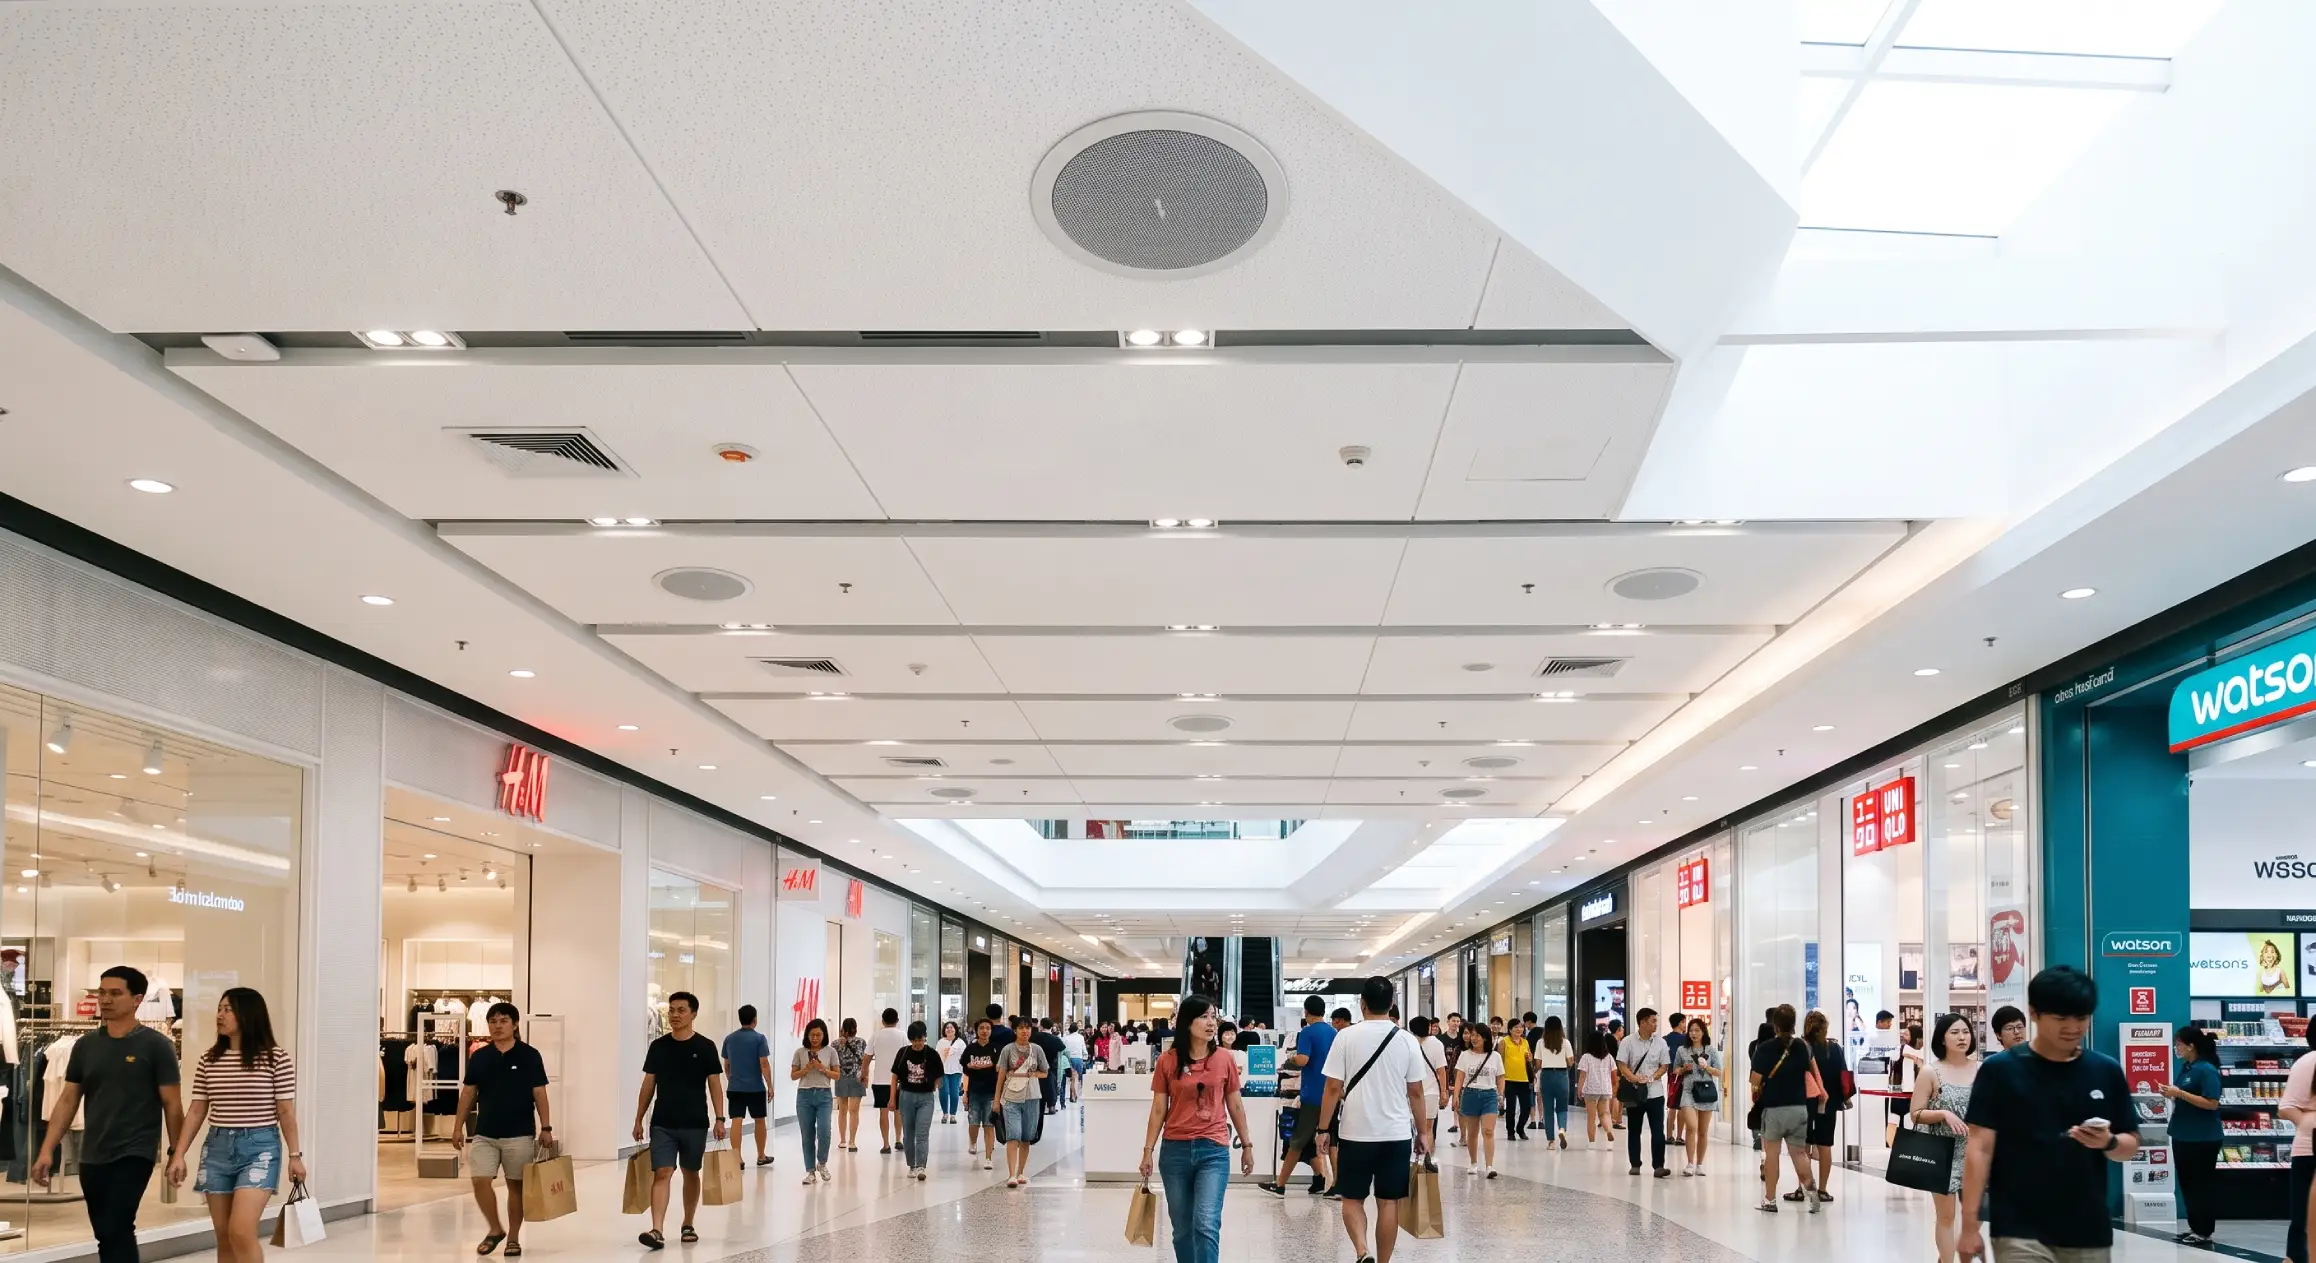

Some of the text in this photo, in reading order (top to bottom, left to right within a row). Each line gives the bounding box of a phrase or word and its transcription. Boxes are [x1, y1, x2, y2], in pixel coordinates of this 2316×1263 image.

[2191, 651, 2316, 725] watso
[1884, 785, 1903, 814] UNI
[1884, 812, 1905, 843] QLO
